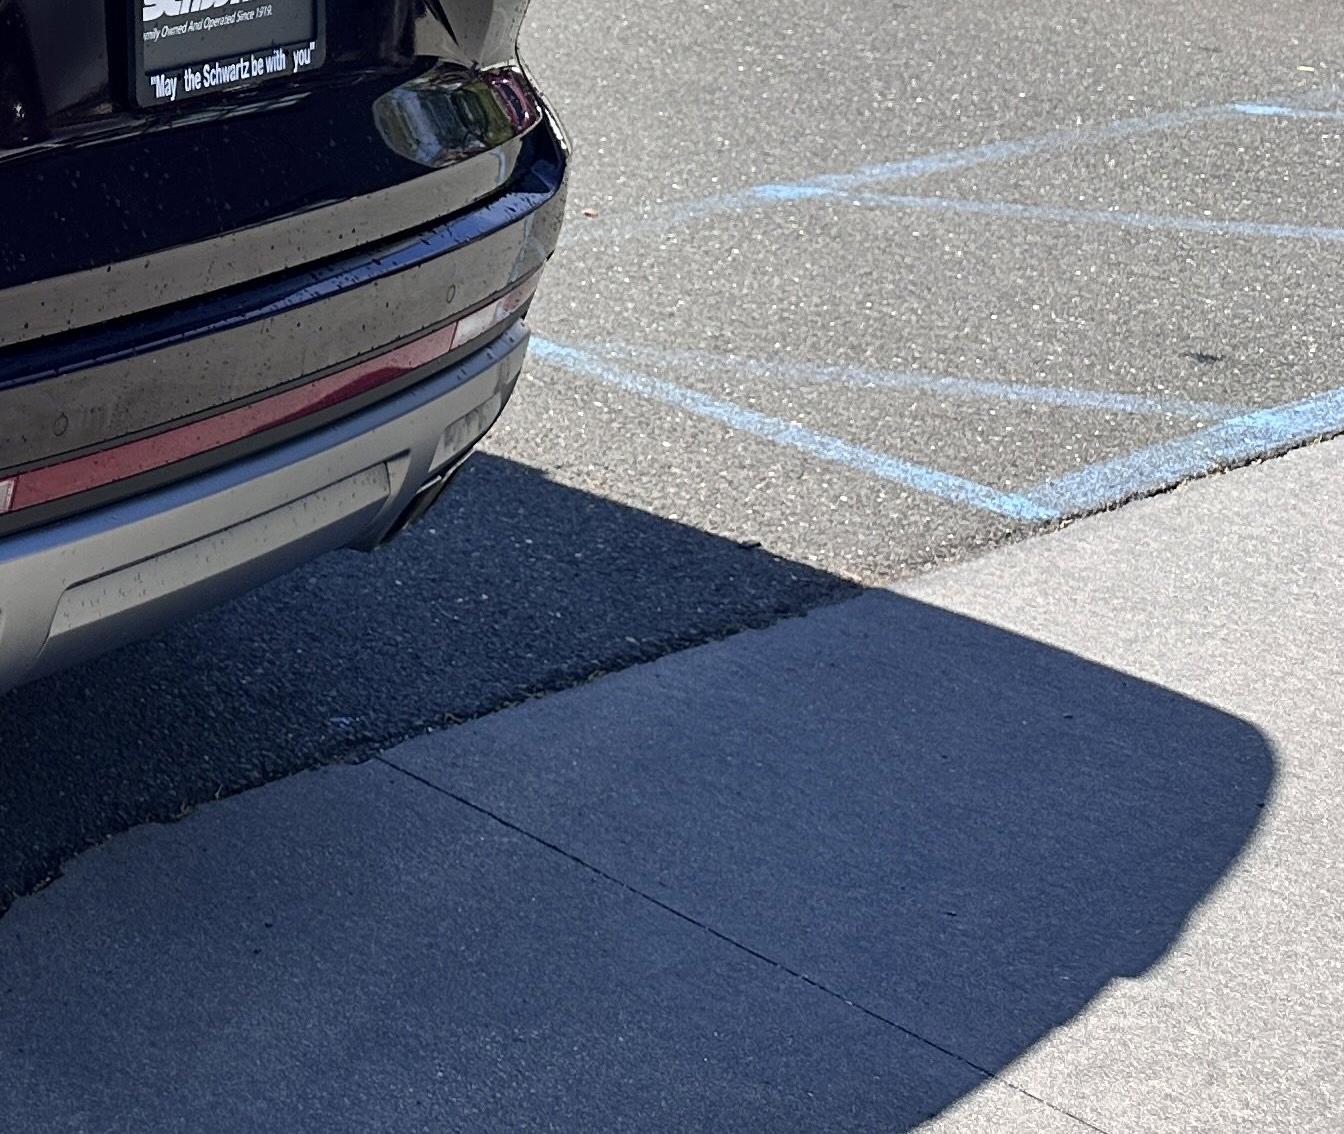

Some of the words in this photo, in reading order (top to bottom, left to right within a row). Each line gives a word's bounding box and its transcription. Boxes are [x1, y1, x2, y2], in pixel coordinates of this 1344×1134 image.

[188, 18, 203, 32] And
[203, 12, 236, 31] Operated
[236, 9, 255, 23] Since
[184, 67, 201, 92] the
[202, 57, 250, 88] Schwartz
[251, 54, 265, 77] be
[265, 48, 286, 73] with
